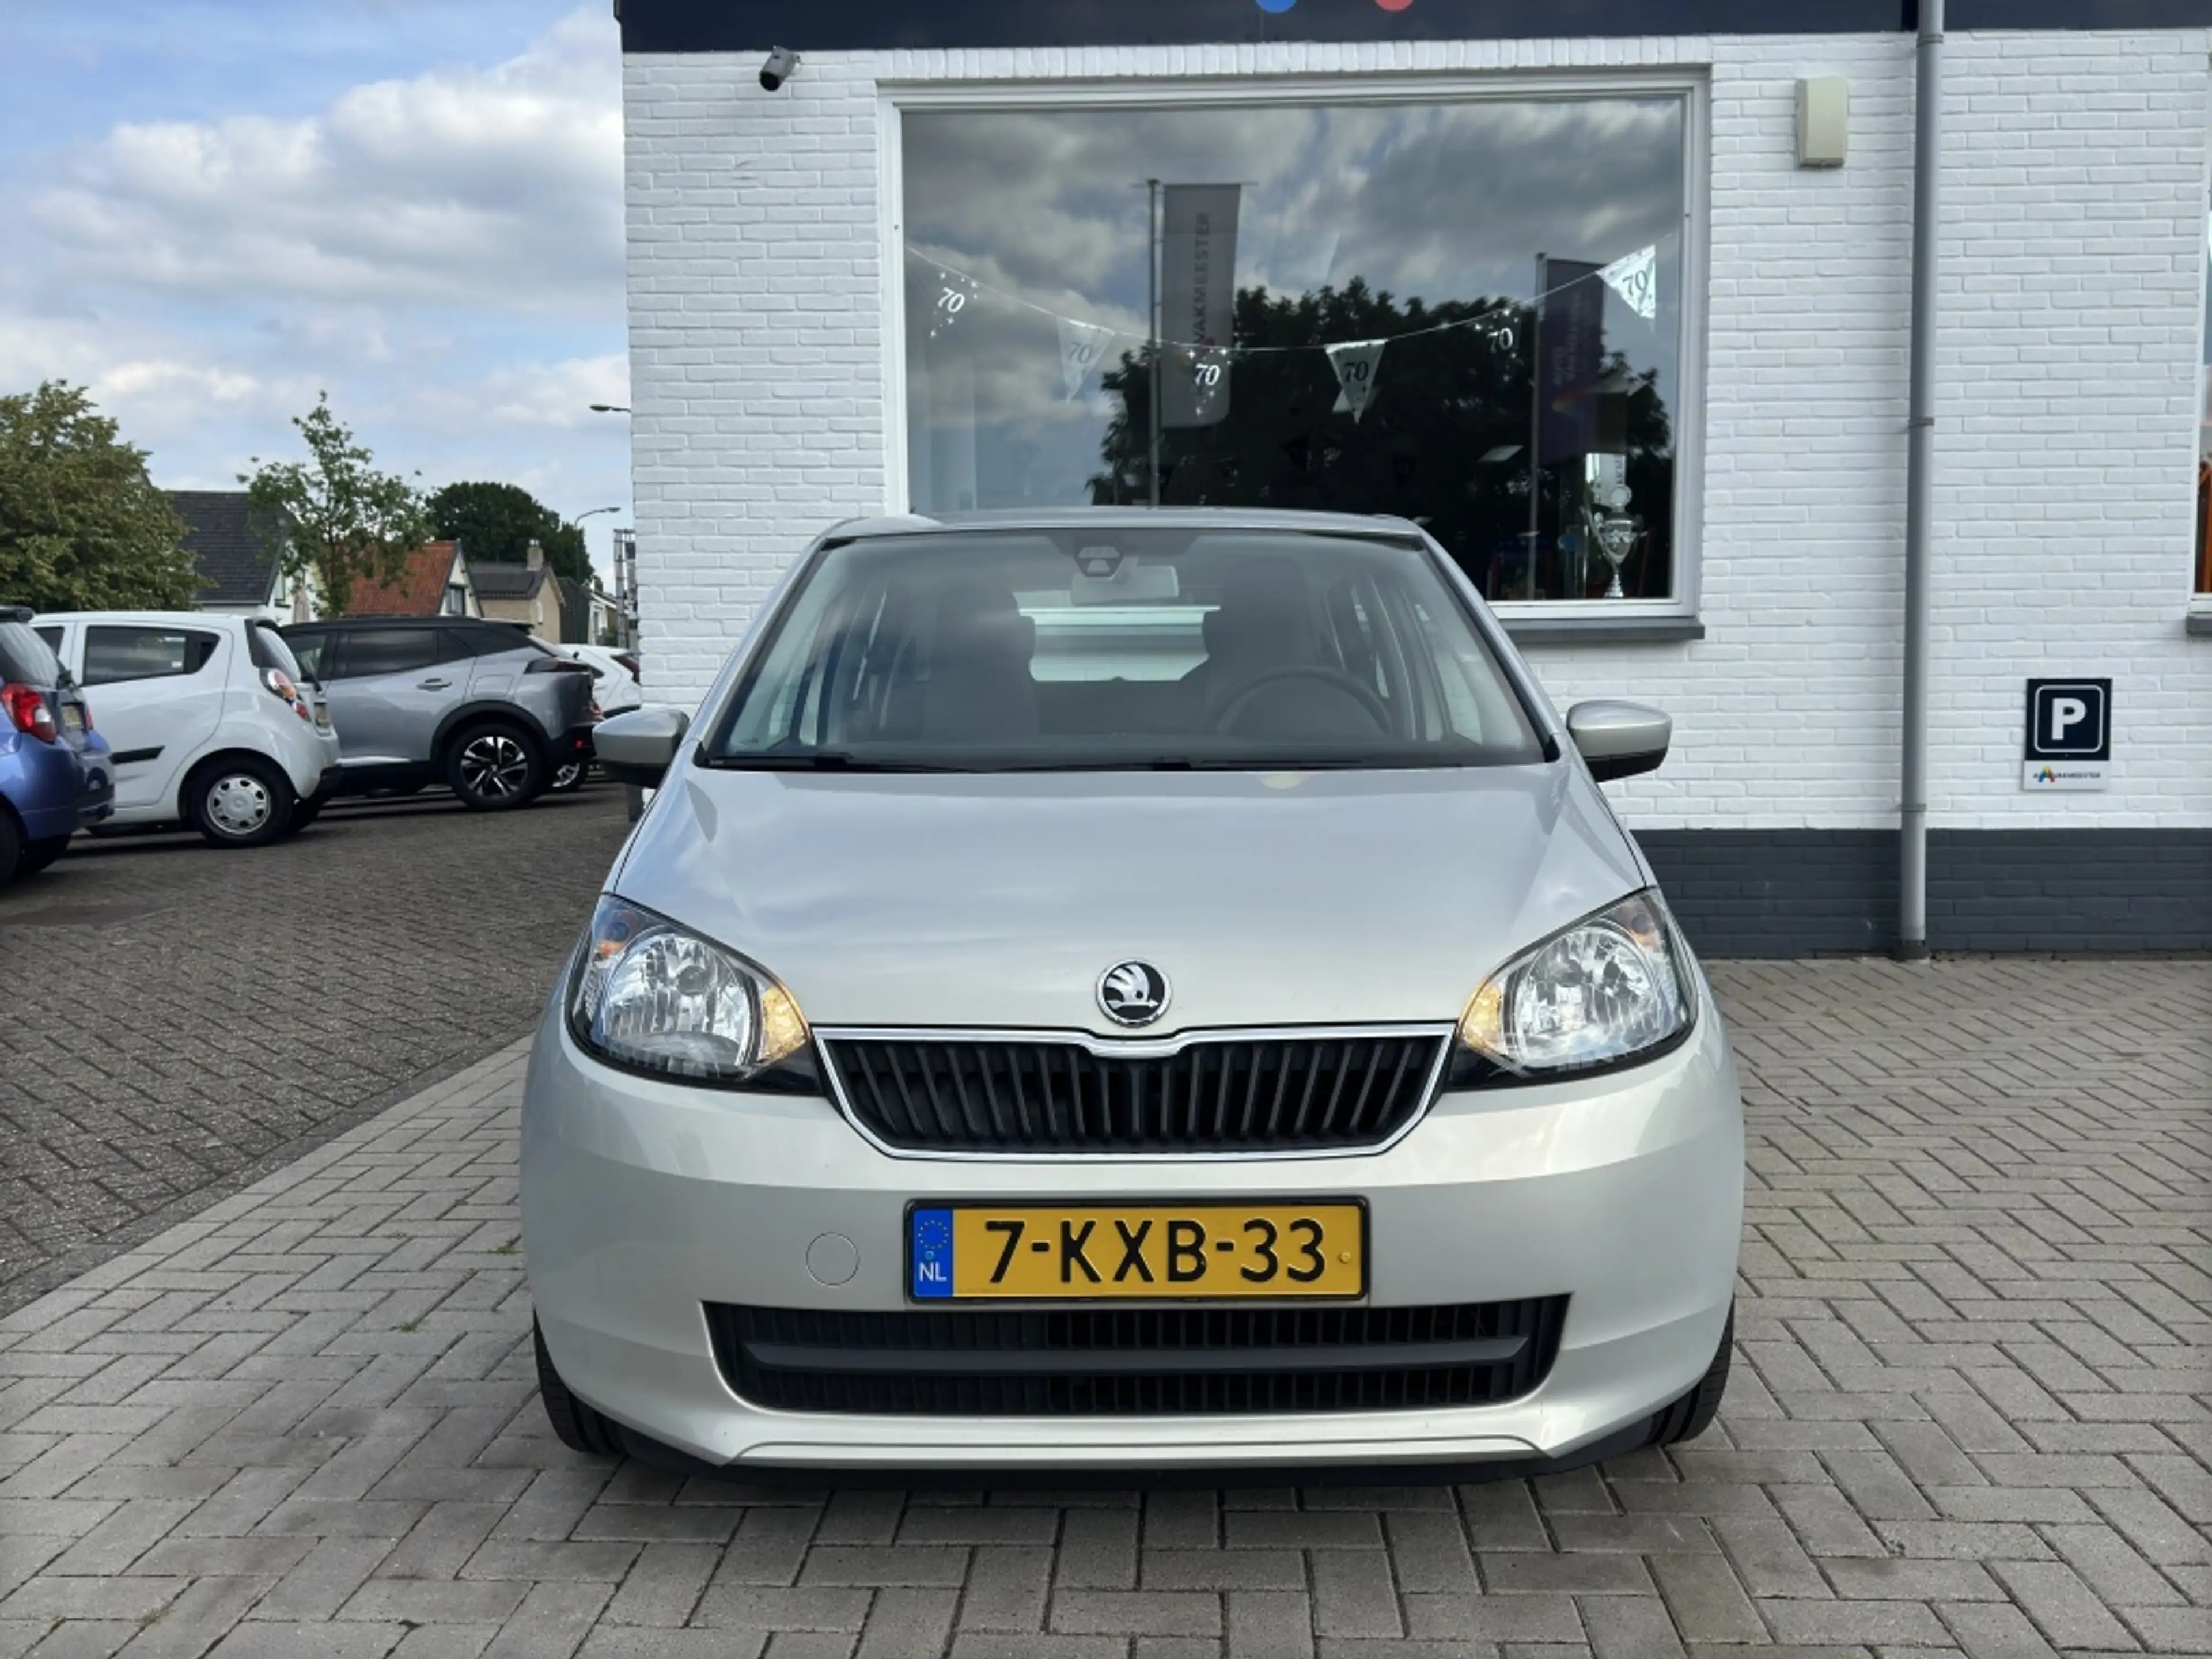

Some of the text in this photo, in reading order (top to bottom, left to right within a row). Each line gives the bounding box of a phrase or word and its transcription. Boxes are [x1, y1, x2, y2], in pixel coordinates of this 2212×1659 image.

[1192, 212, 1210, 344] VAKMEESTER
[1622, 270, 1649, 296] 70
[937, 286, 965, 313] 70
[1067, 341, 1094, 364] 70
[1486, 327, 1513, 354] 70
[1194, 363, 1221, 386] 70
[1344, 361, 1369, 382] 70
[2051, 697, 2087, 741] P
[984, 1218, 1327, 1284] 7-KXB-33
[918, 1261, 948, 1282] NL
